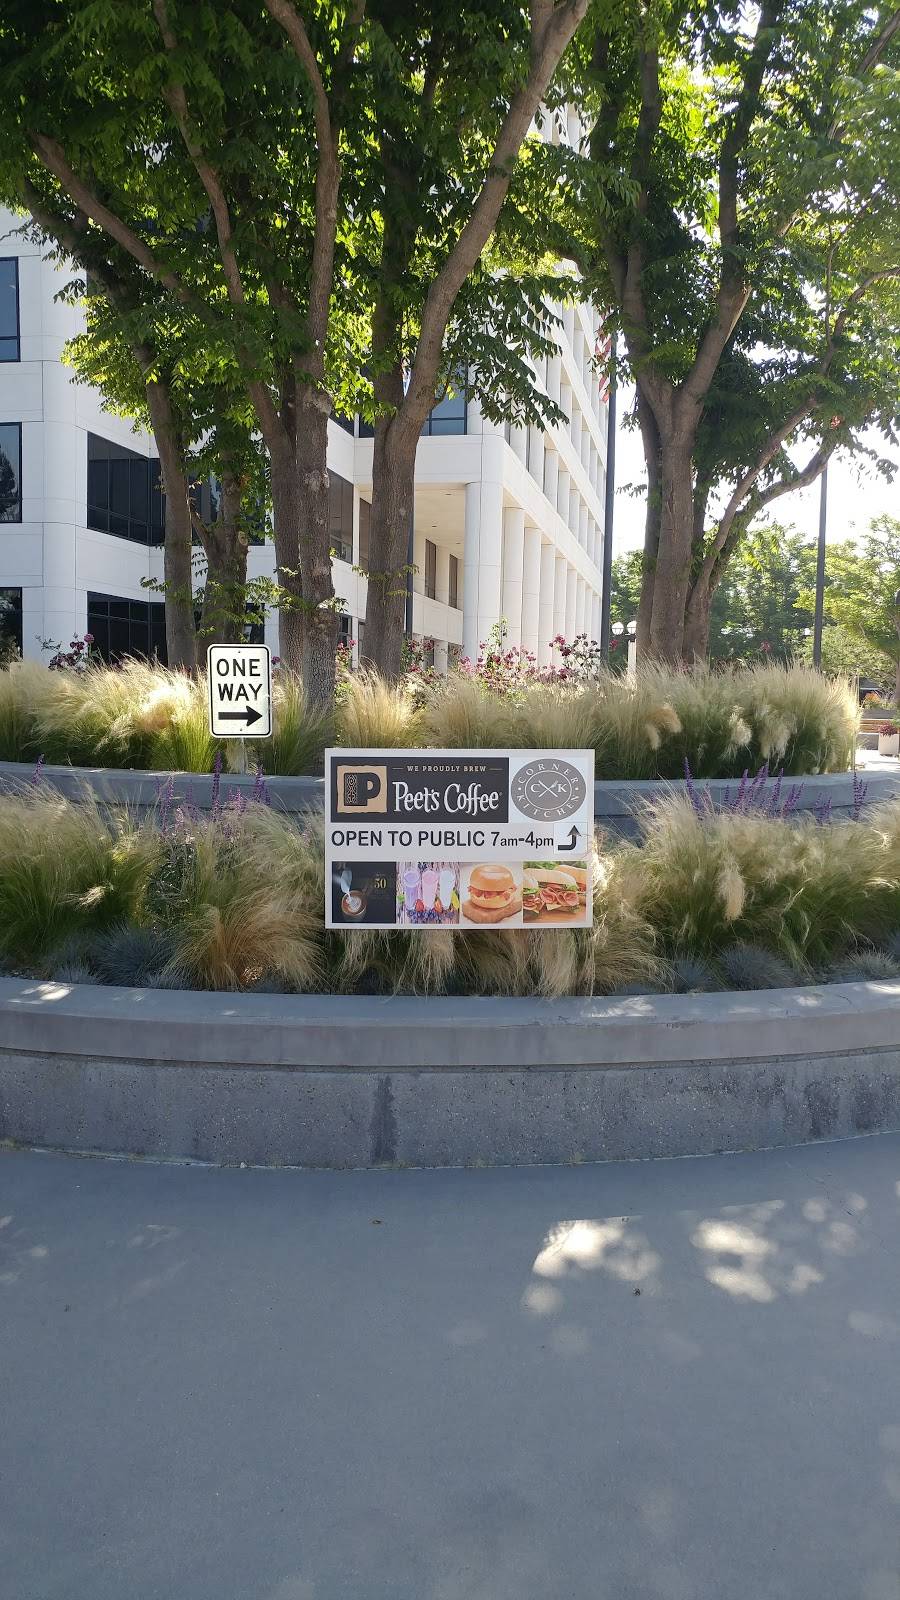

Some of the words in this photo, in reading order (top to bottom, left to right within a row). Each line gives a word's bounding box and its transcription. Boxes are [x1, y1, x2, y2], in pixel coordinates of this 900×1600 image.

[216, 658, 261, 676] ONE
[217, 684, 262, 702] WAY
[517, 763, 580, 784] CORNER
[392, 781, 440, 813] Peet's
[444, 782, 500, 816] Coffee
[516, 794, 580, 818] KITCHEN
[331, 830, 383, 847] OPEN
[387, 830, 413, 847] TO
[418, 830, 485, 847] PUBLIC
[490, 831, 554, 849] 7am-4pm
